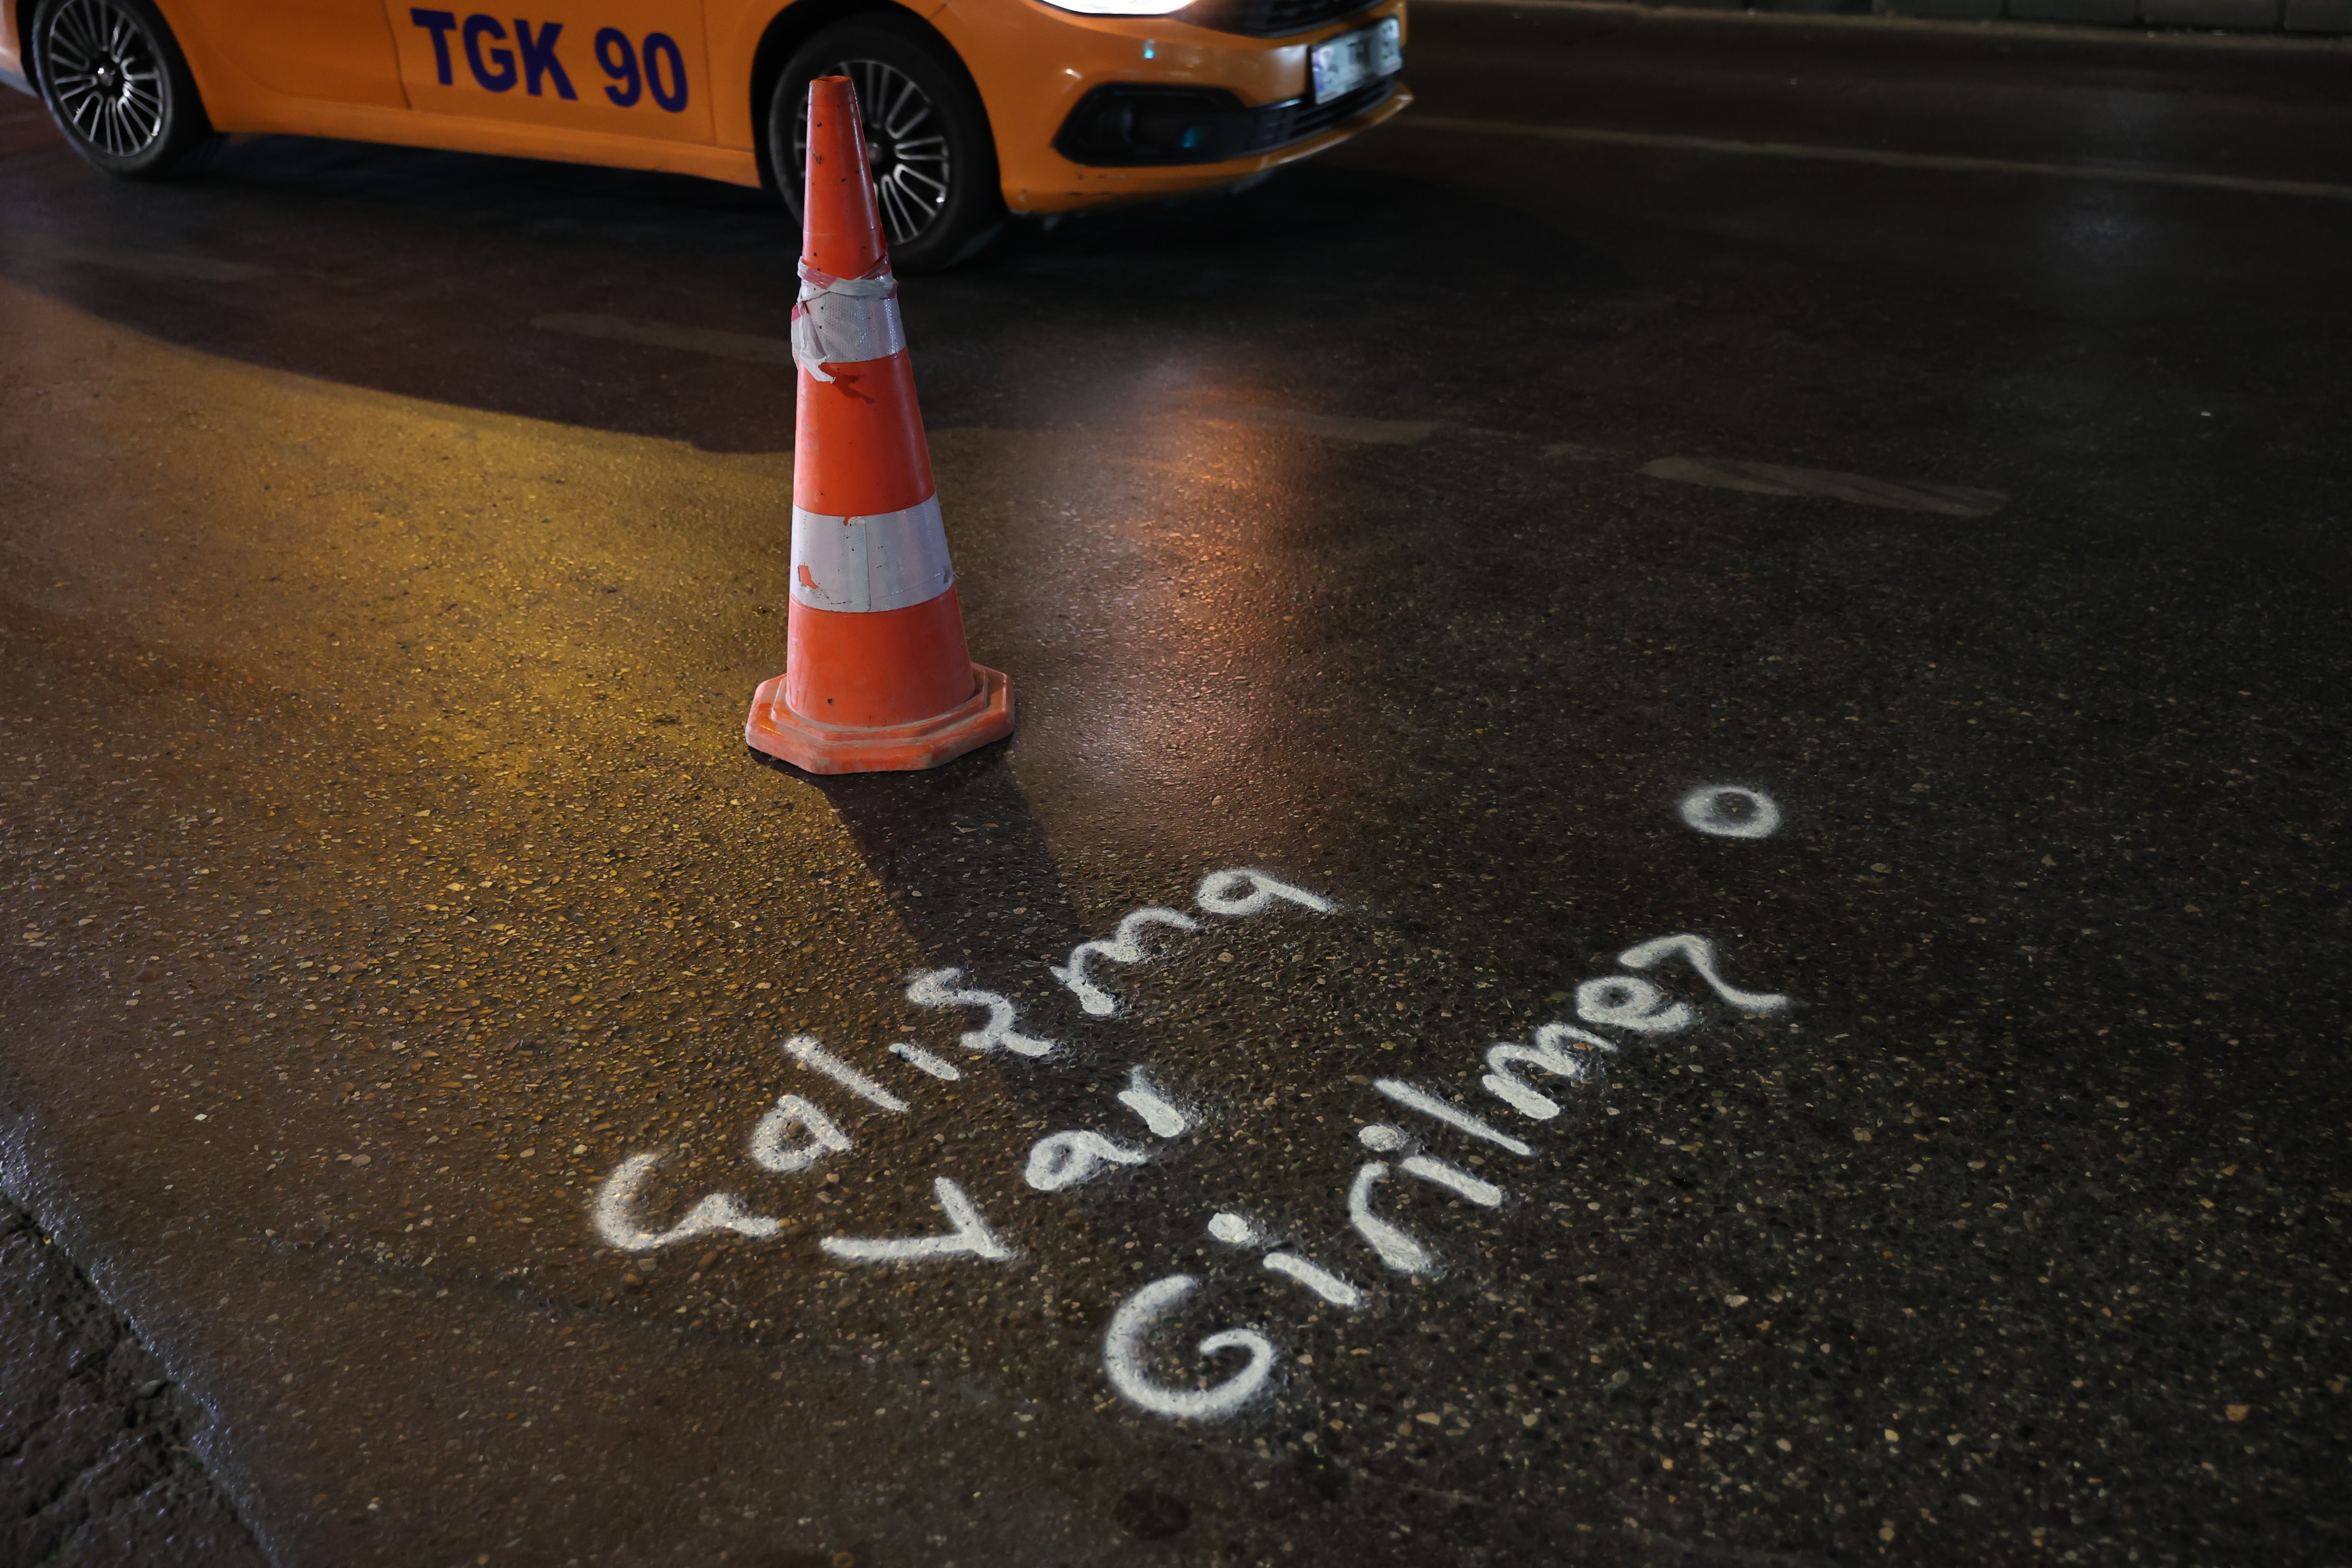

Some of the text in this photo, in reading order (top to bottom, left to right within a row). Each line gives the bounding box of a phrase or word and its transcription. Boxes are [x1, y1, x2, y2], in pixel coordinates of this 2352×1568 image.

[410, 8, 689, 113] TGK 90
[819, 1065, 1188, 1262] Var
[1104, 933, 1790, 1420] Girilmez
